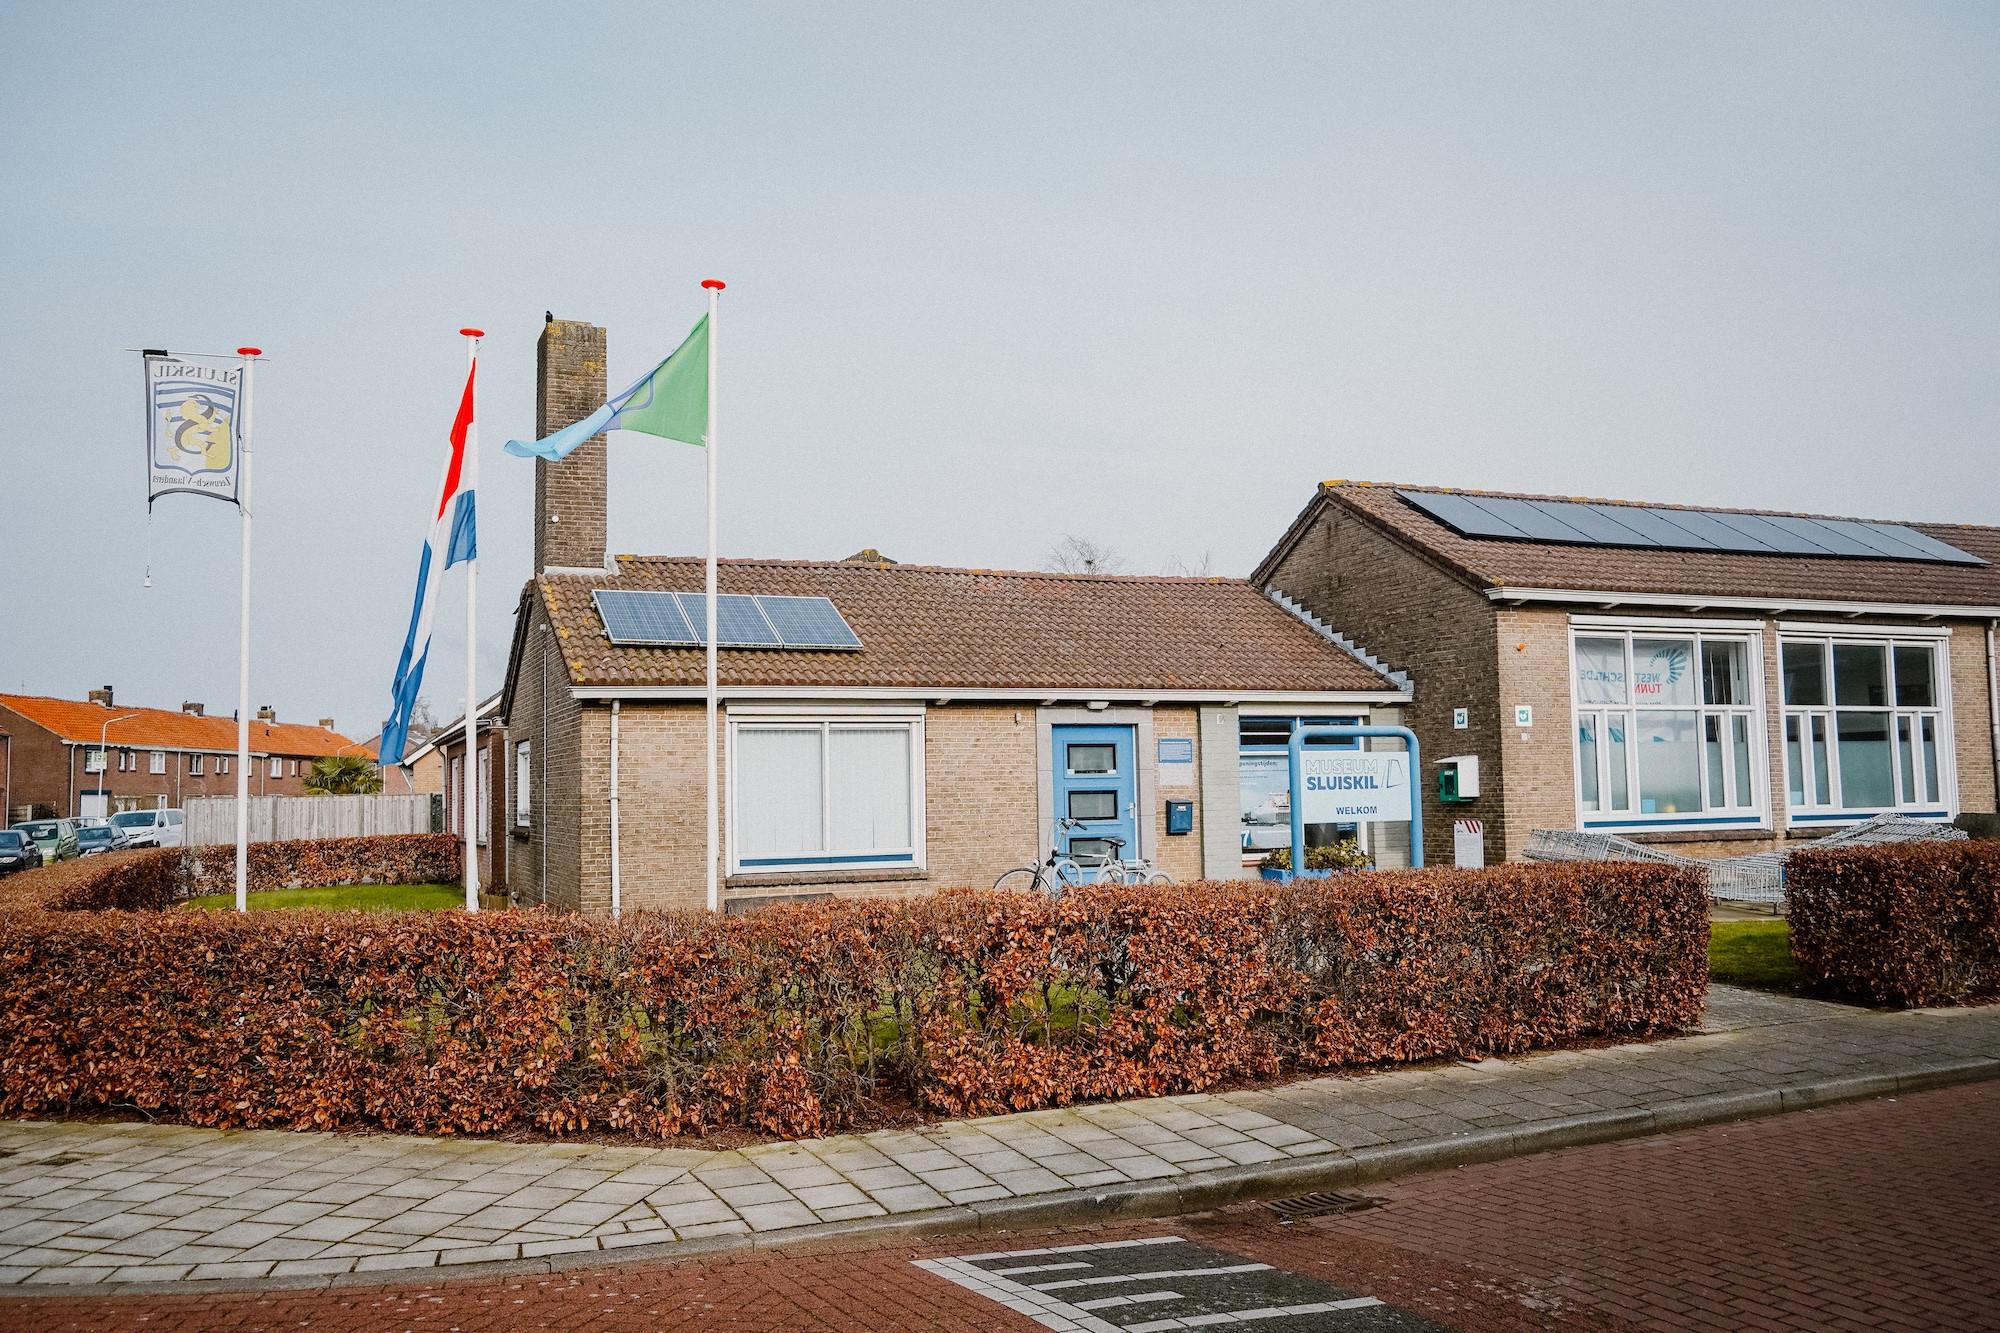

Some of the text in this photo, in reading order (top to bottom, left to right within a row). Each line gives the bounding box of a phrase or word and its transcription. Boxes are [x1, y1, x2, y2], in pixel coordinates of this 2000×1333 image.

[1305, 759, 1378, 775] MUSEUM
[1306, 775, 1379, 791] SLUISKIL
[1336, 806, 1378, 815] WELKOM
